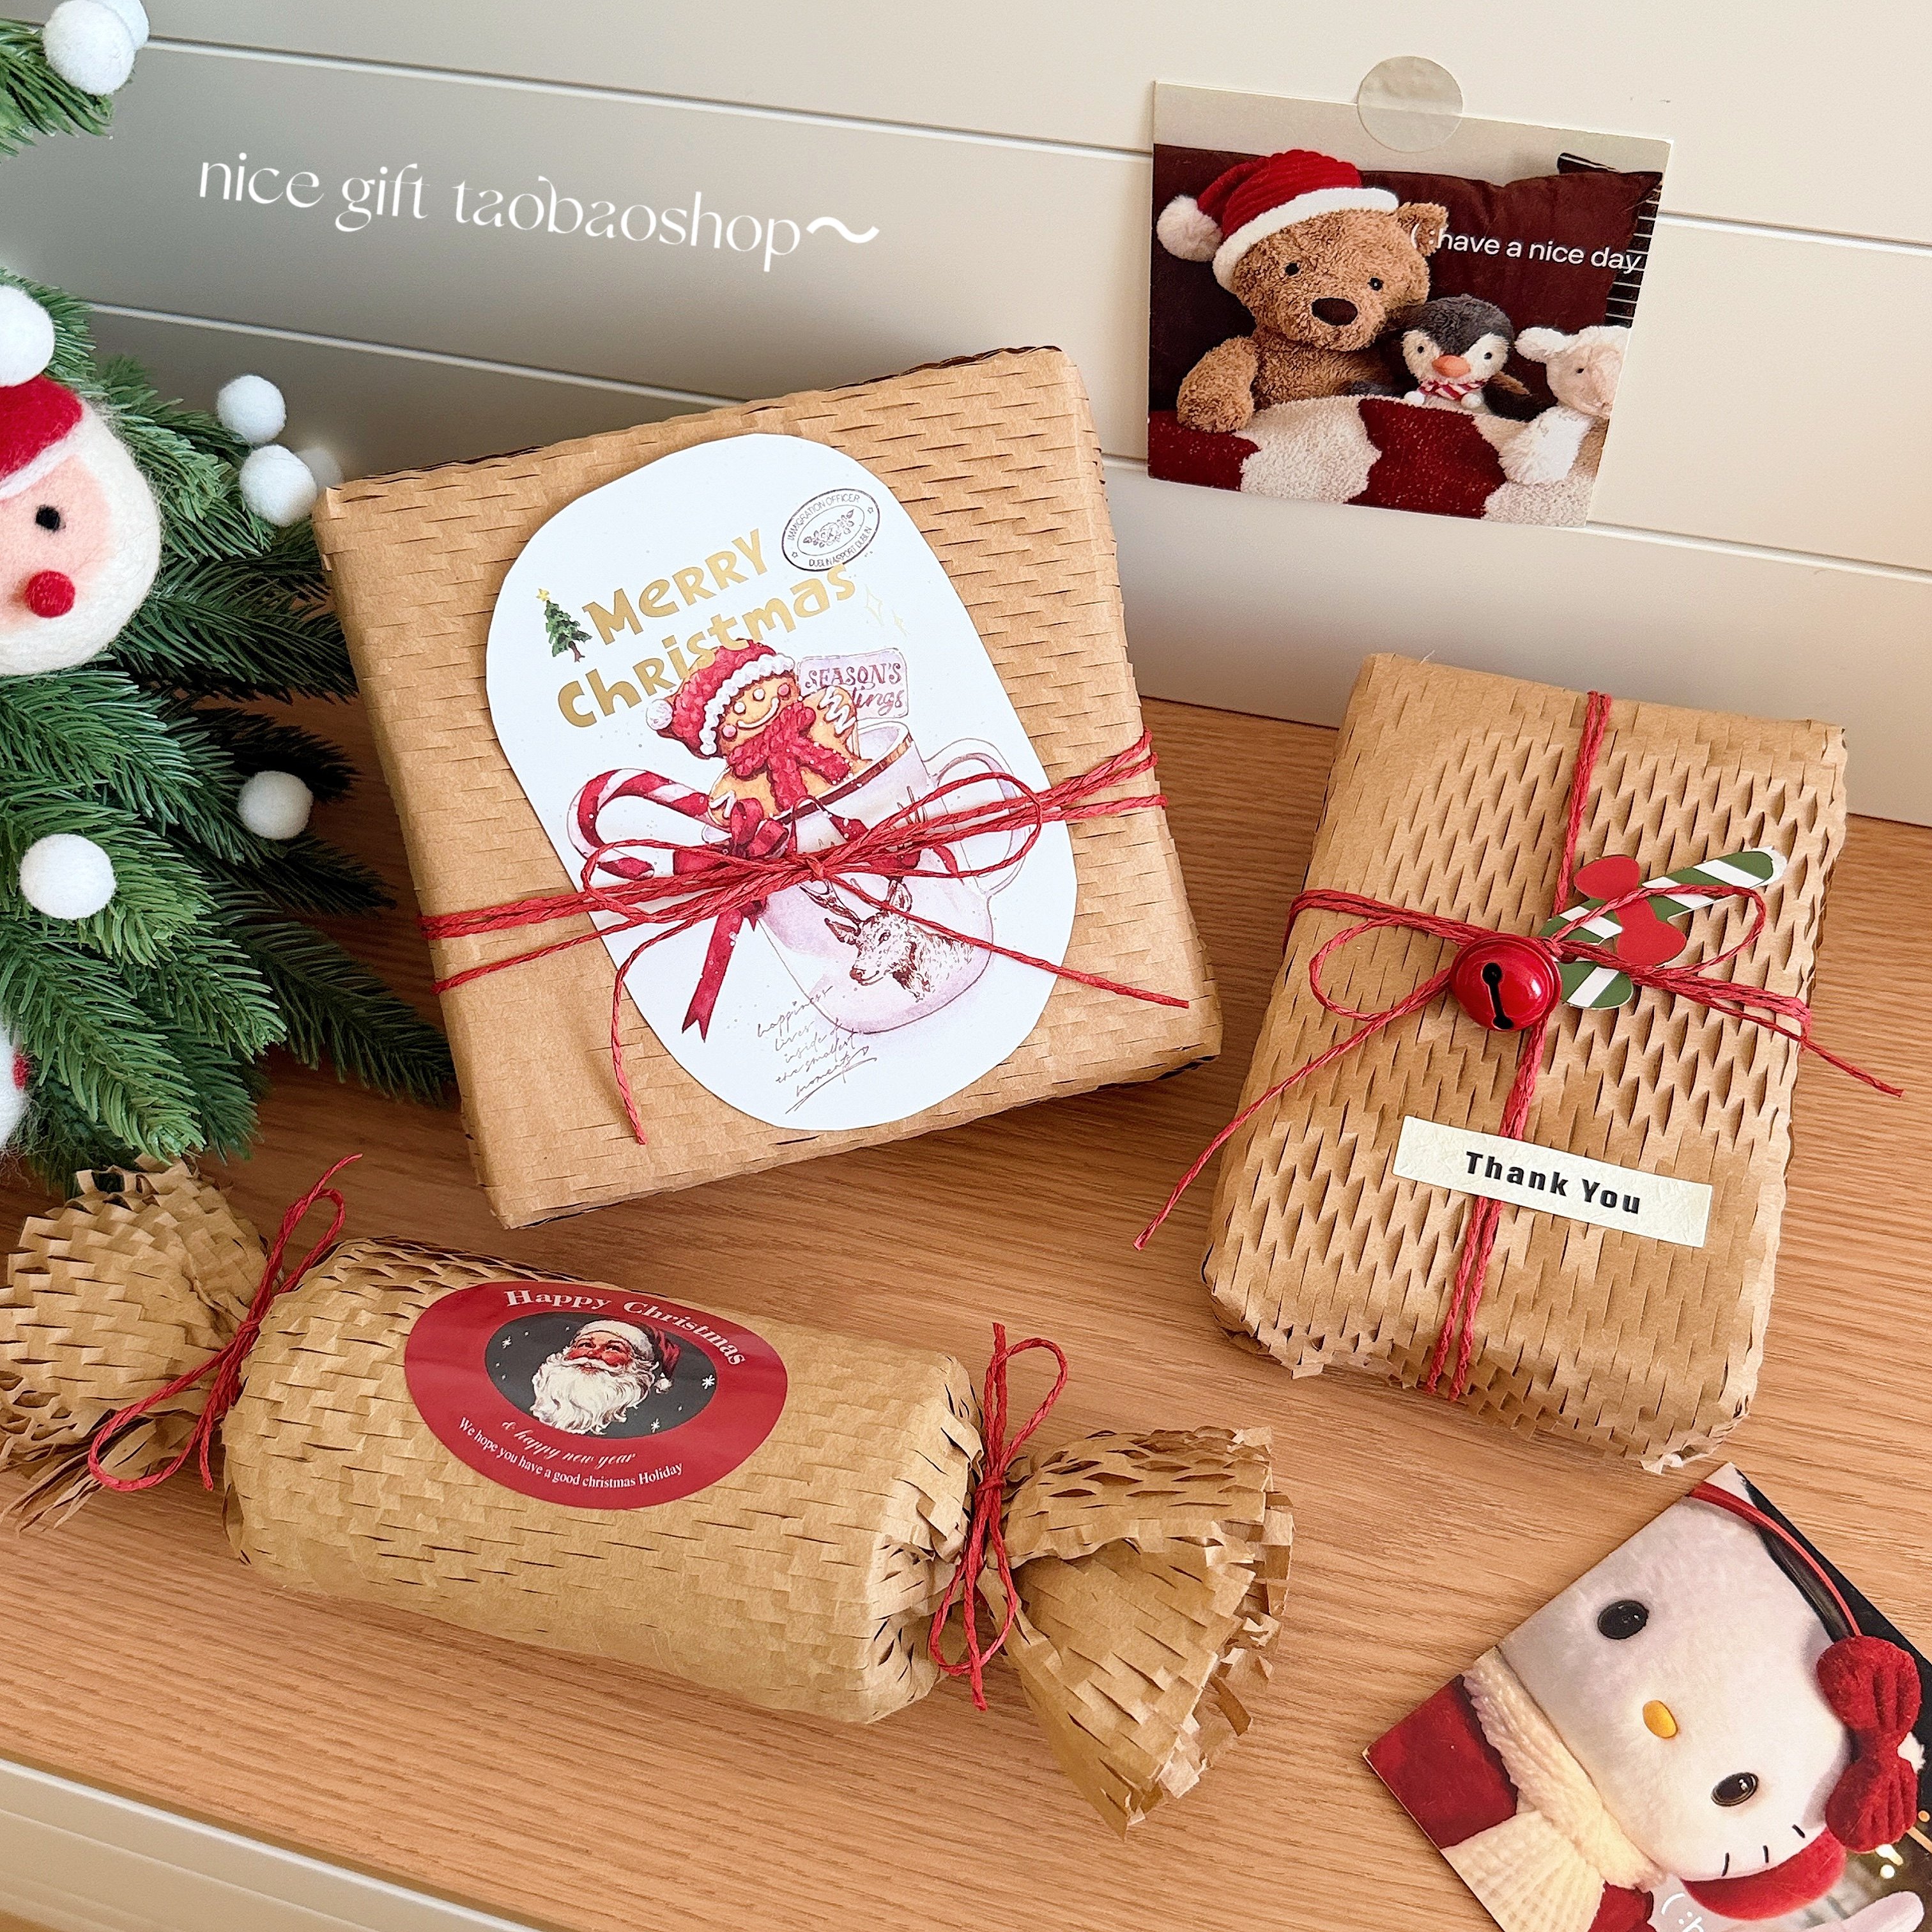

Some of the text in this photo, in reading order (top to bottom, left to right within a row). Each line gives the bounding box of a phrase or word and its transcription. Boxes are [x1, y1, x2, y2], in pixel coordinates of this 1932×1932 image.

[1505, 241, 1522, 259] a
[1528, 240, 1584, 265] nice
[1590, 247, 1644, 275] day
[825, 493, 861, 507] OFFICER
[805, 662, 901, 689] SEASON'S
[1465, 1150, 1641, 1215] Thank You
[503, 1289, 747, 1366] Happy Christmas
[459, 1416, 683, 1488] We hope you have a good christmas Holiday
[514, 1429, 562, 1460] happy
[562, 1452, 595, 1464] new
[594, 1453, 637, 1470] year
